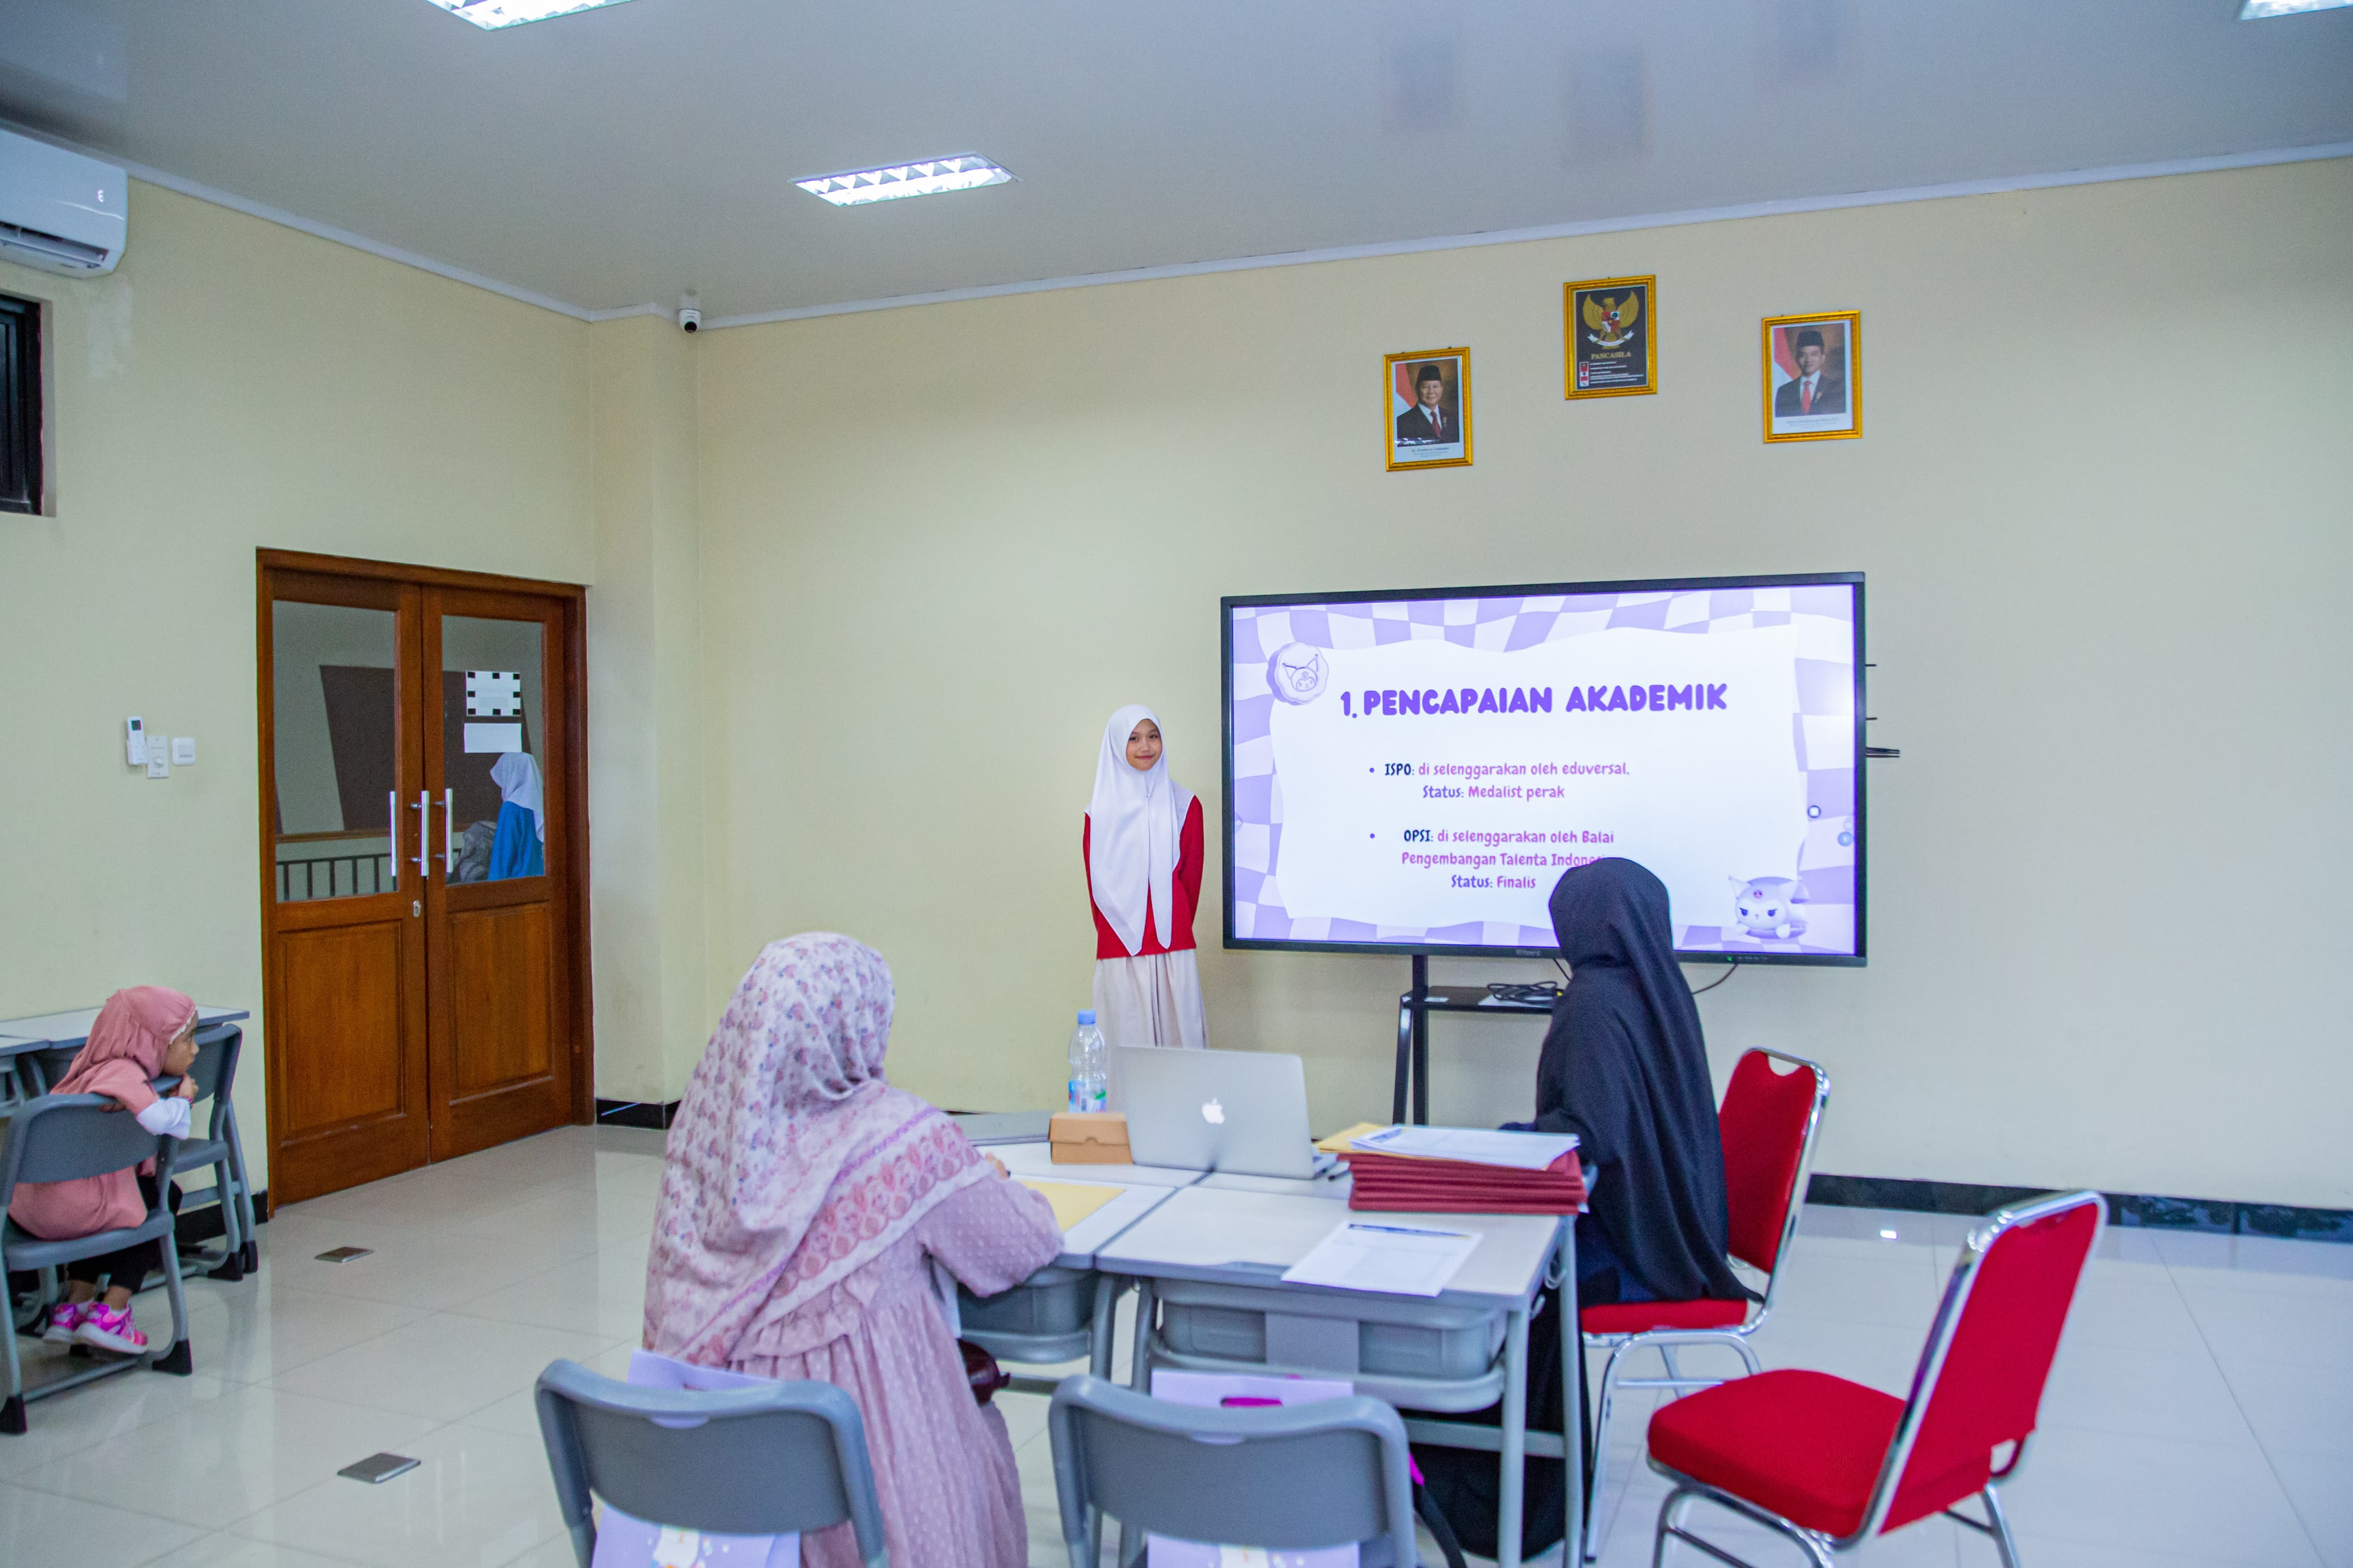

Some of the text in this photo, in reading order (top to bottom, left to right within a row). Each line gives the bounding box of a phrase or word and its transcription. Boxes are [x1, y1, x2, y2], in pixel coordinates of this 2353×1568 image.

[1341, 683, 1727, 719] 1. PENCAPAIAN AKADEMIK
[1385, 762, 1629, 780] ISPO: di selenggarakan oleh eduversal.
[1423, 785, 1565, 802] Status: Medalist perak
[1404, 829, 1614, 847] OPSI: di selenggarakan oleh Balai
[1402, 852, 1496, 870] Pengembangan
[1499, 853, 1547, 866] Talenta
[1451, 874, 1536, 889] Status: Finalis
